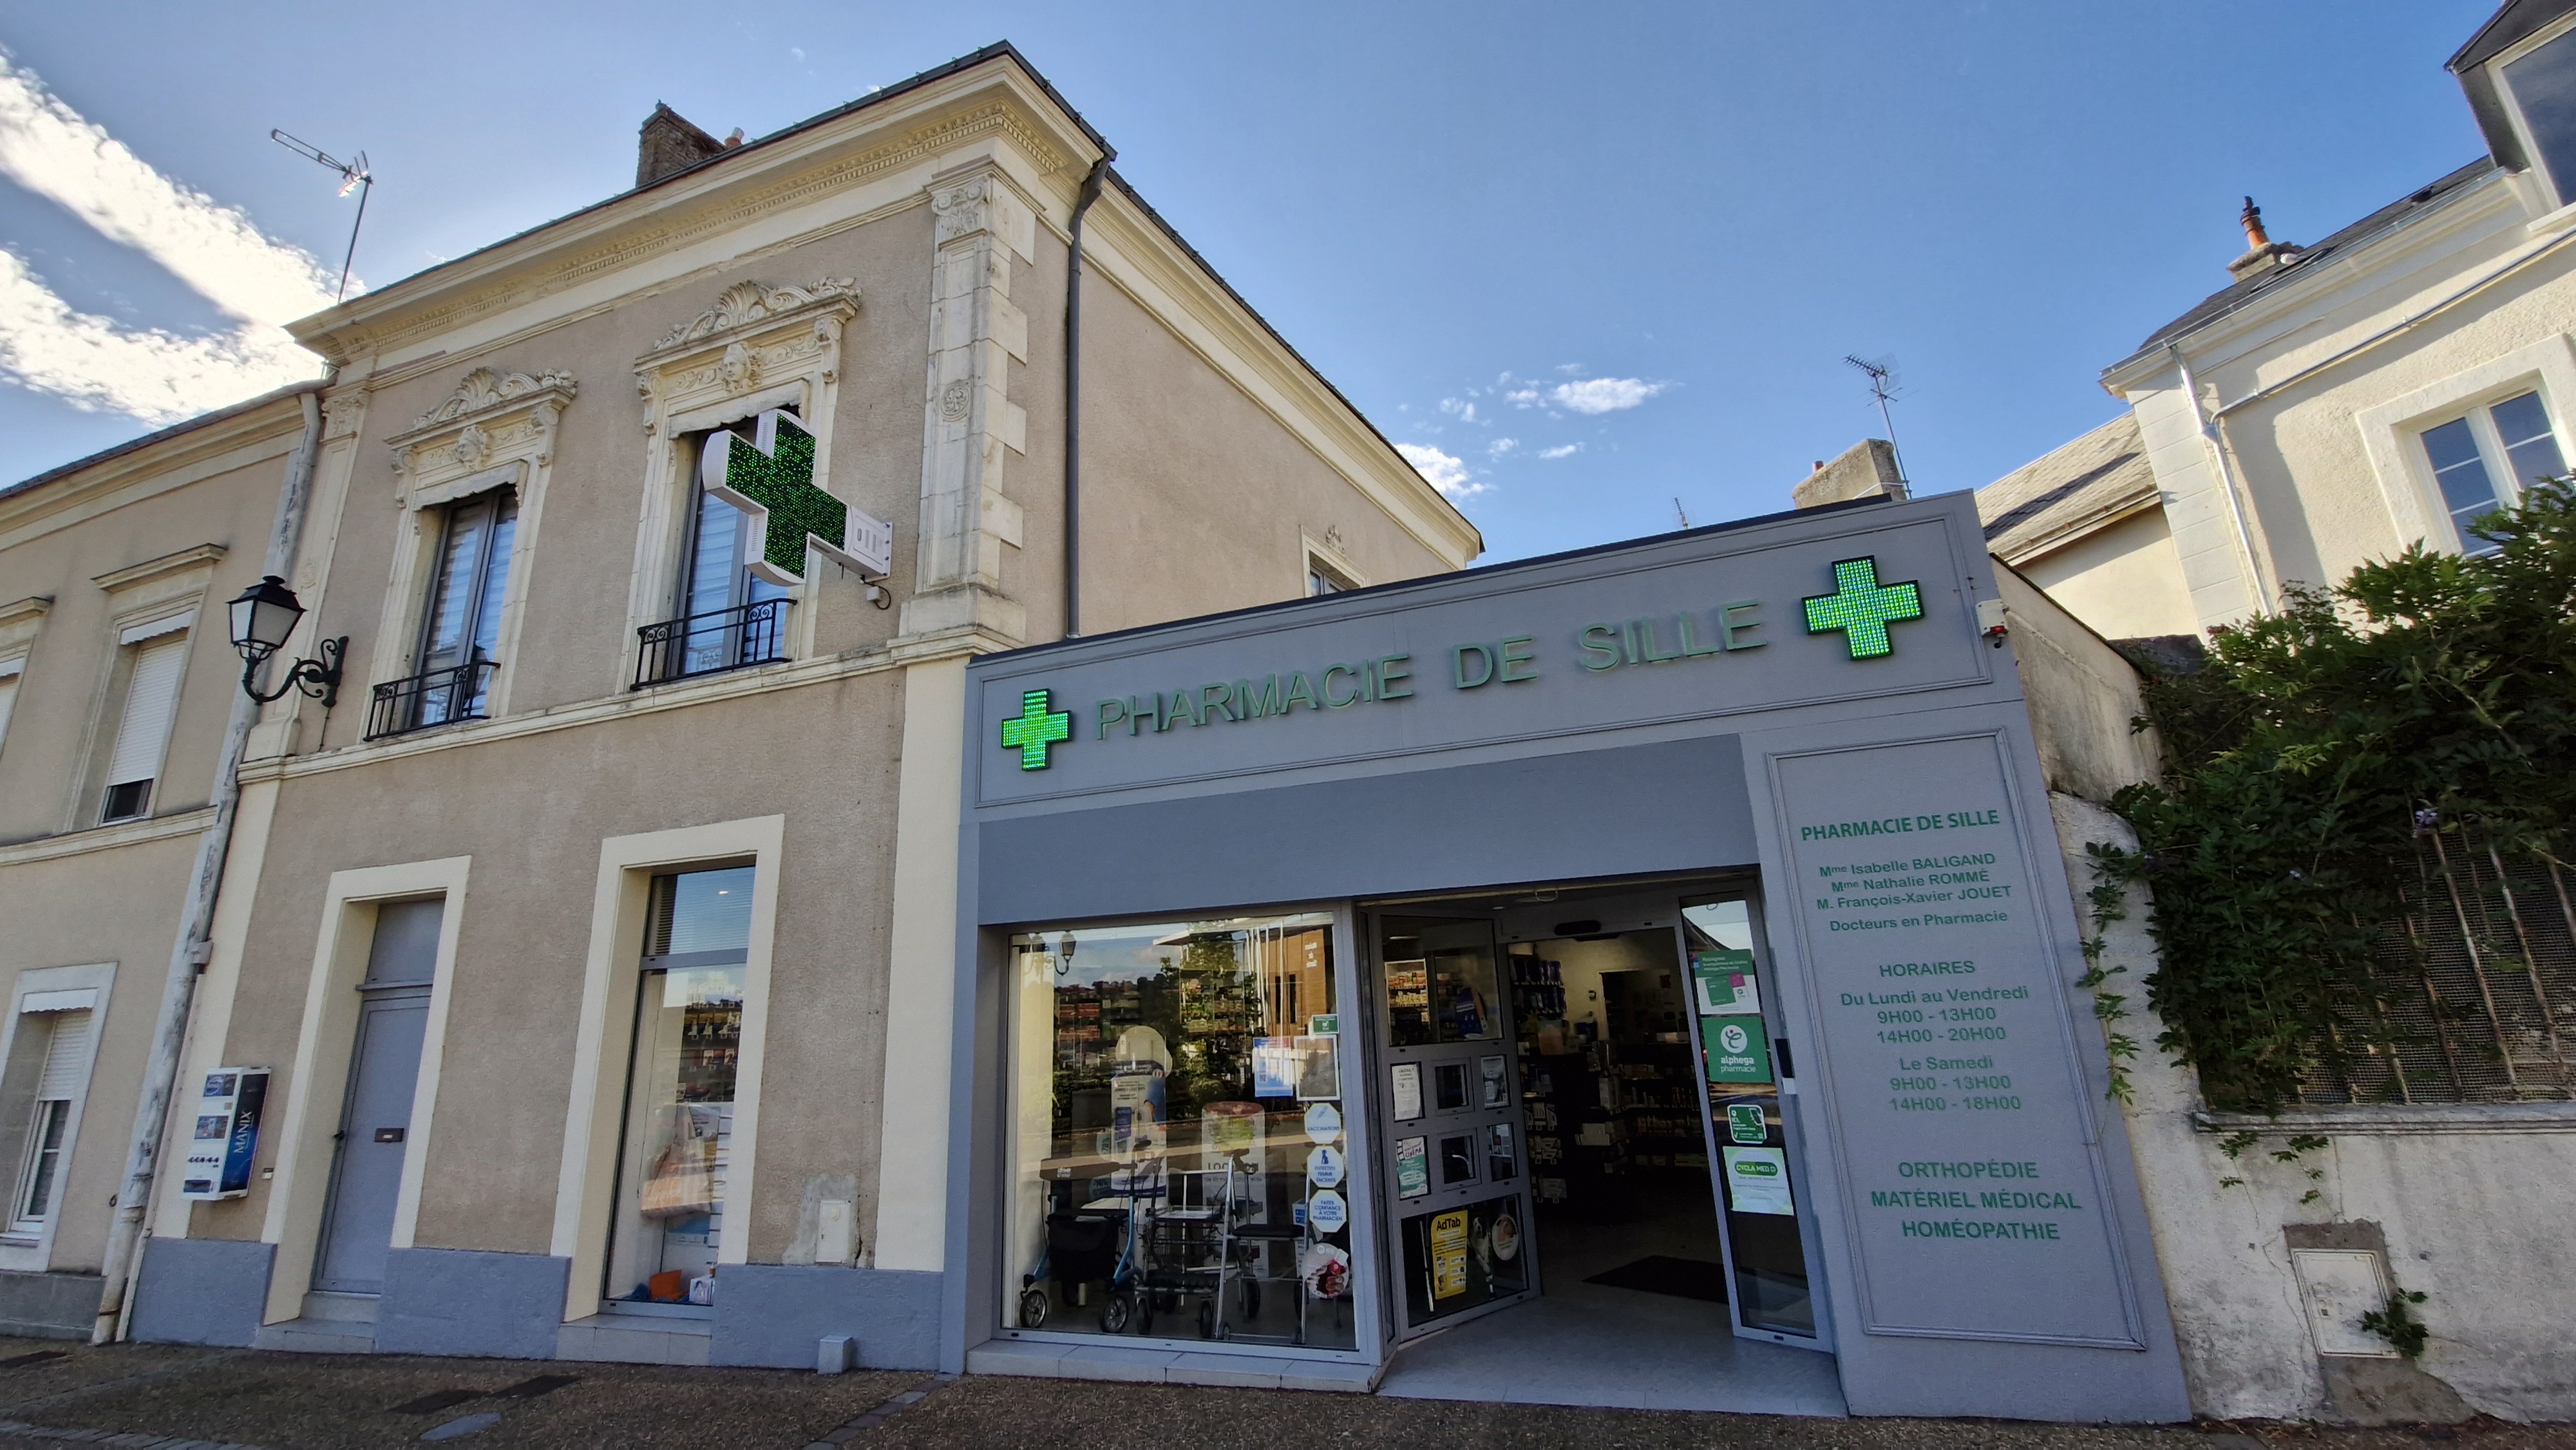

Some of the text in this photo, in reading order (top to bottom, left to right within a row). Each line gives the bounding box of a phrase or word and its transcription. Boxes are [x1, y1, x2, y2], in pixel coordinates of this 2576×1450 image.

[1096, 599, 1768, 740] PHARMACIE DE SILLE
[1802, 809, 2000, 841] PHARMACIE DE SILLE
[1819, 852, 1996, 878] Mme Isabelle BALIGAND
[1832, 869, 1989, 892] Mme Nathalie ROMMÉ
[1817, 885, 2011, 910] M. François-Xavier JOUET
[1830, 910, 2007, 931] Docteurs en Pharmacie
[1880, 960, 1975, 978] HORAIRES
[1841, 986, 2029, 1006] Du Lundi au Vendredi
[1877, 1010, 1922, 1024] 9H00
[1940, 1007, 1996, 1022] 13H00
[1877, 1030, 1933, 1044] 14H00
[1949, 1026, 2006, 1042] 20H00
[1721, 1055, 1754, 1066] alphega
[1721, 1064, 1756, 1073] pharmacie
[1900, 1055, 1993, 1071] Le Samedi
[1890, 1077, 1936, 1091] 9H00
[1952, 1075, 2011, 1090] 13H00
[1889, 1097, 1946, 1111] 14H00
[1962, 1096, 2022, 1110] 18H00
[233, 1110, 252, 1153] MANIX
[1899, 1158, 2040, 1178] ORTHOPÉDIE
[1871, 1187, 2083, 1209] MATÉRIEL MÉDICAL
[1436, 1216, 1461, 1231] AdTab
[1902, 1218, 2060, 1240] HOMÉOPATHIE
